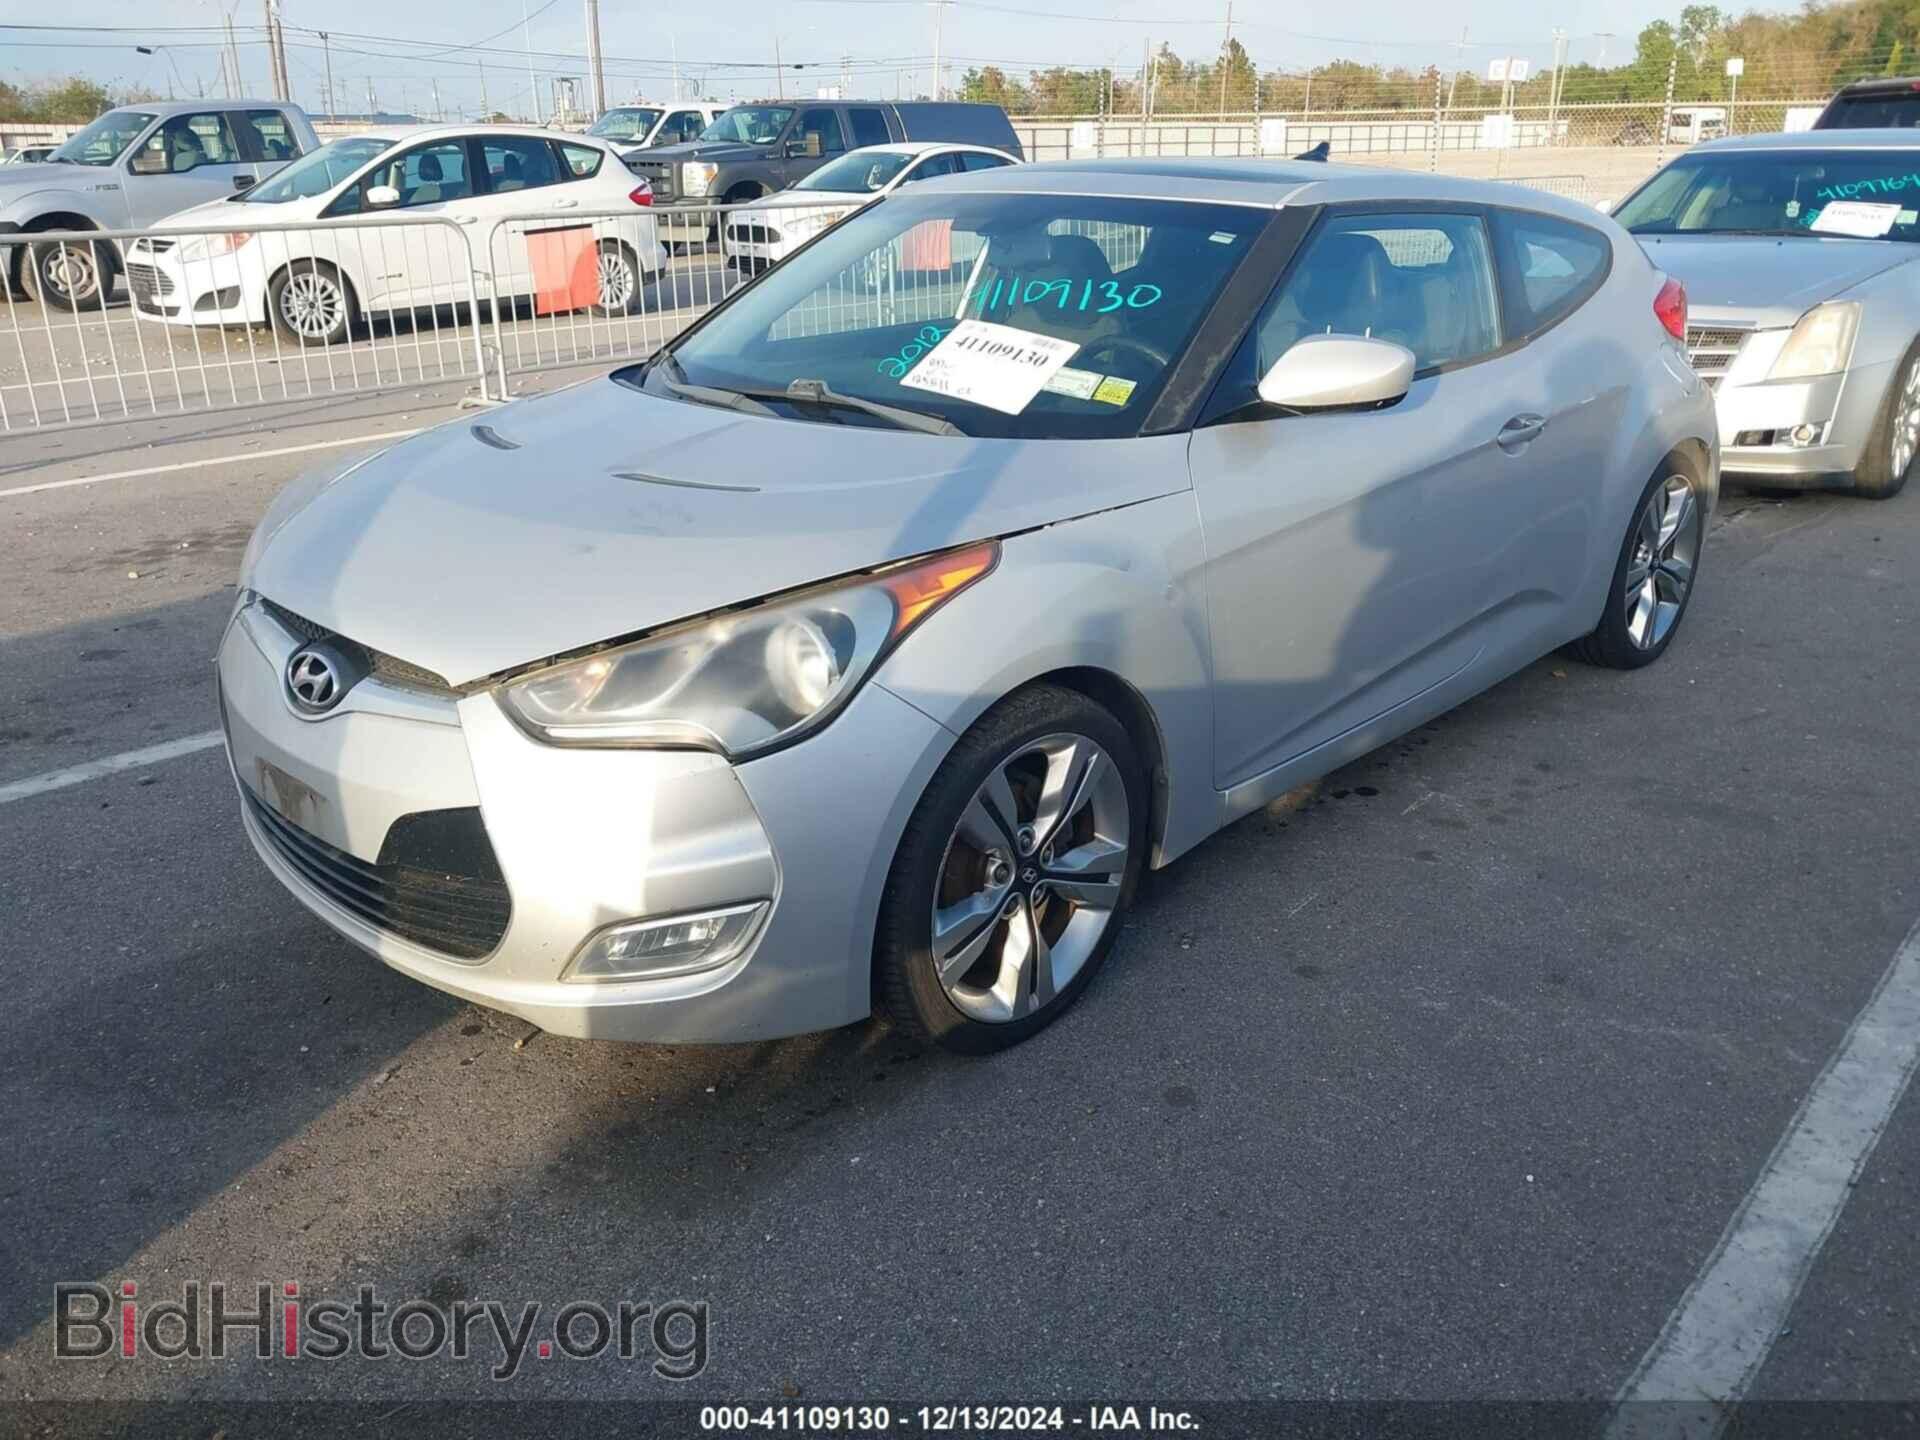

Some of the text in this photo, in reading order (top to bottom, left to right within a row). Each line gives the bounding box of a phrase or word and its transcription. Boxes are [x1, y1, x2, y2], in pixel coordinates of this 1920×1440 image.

[970, 276, 1162, 313] 41109130
[878, 325, 953, 378] 2012
[955, 335, 1049, 367] 41109130
